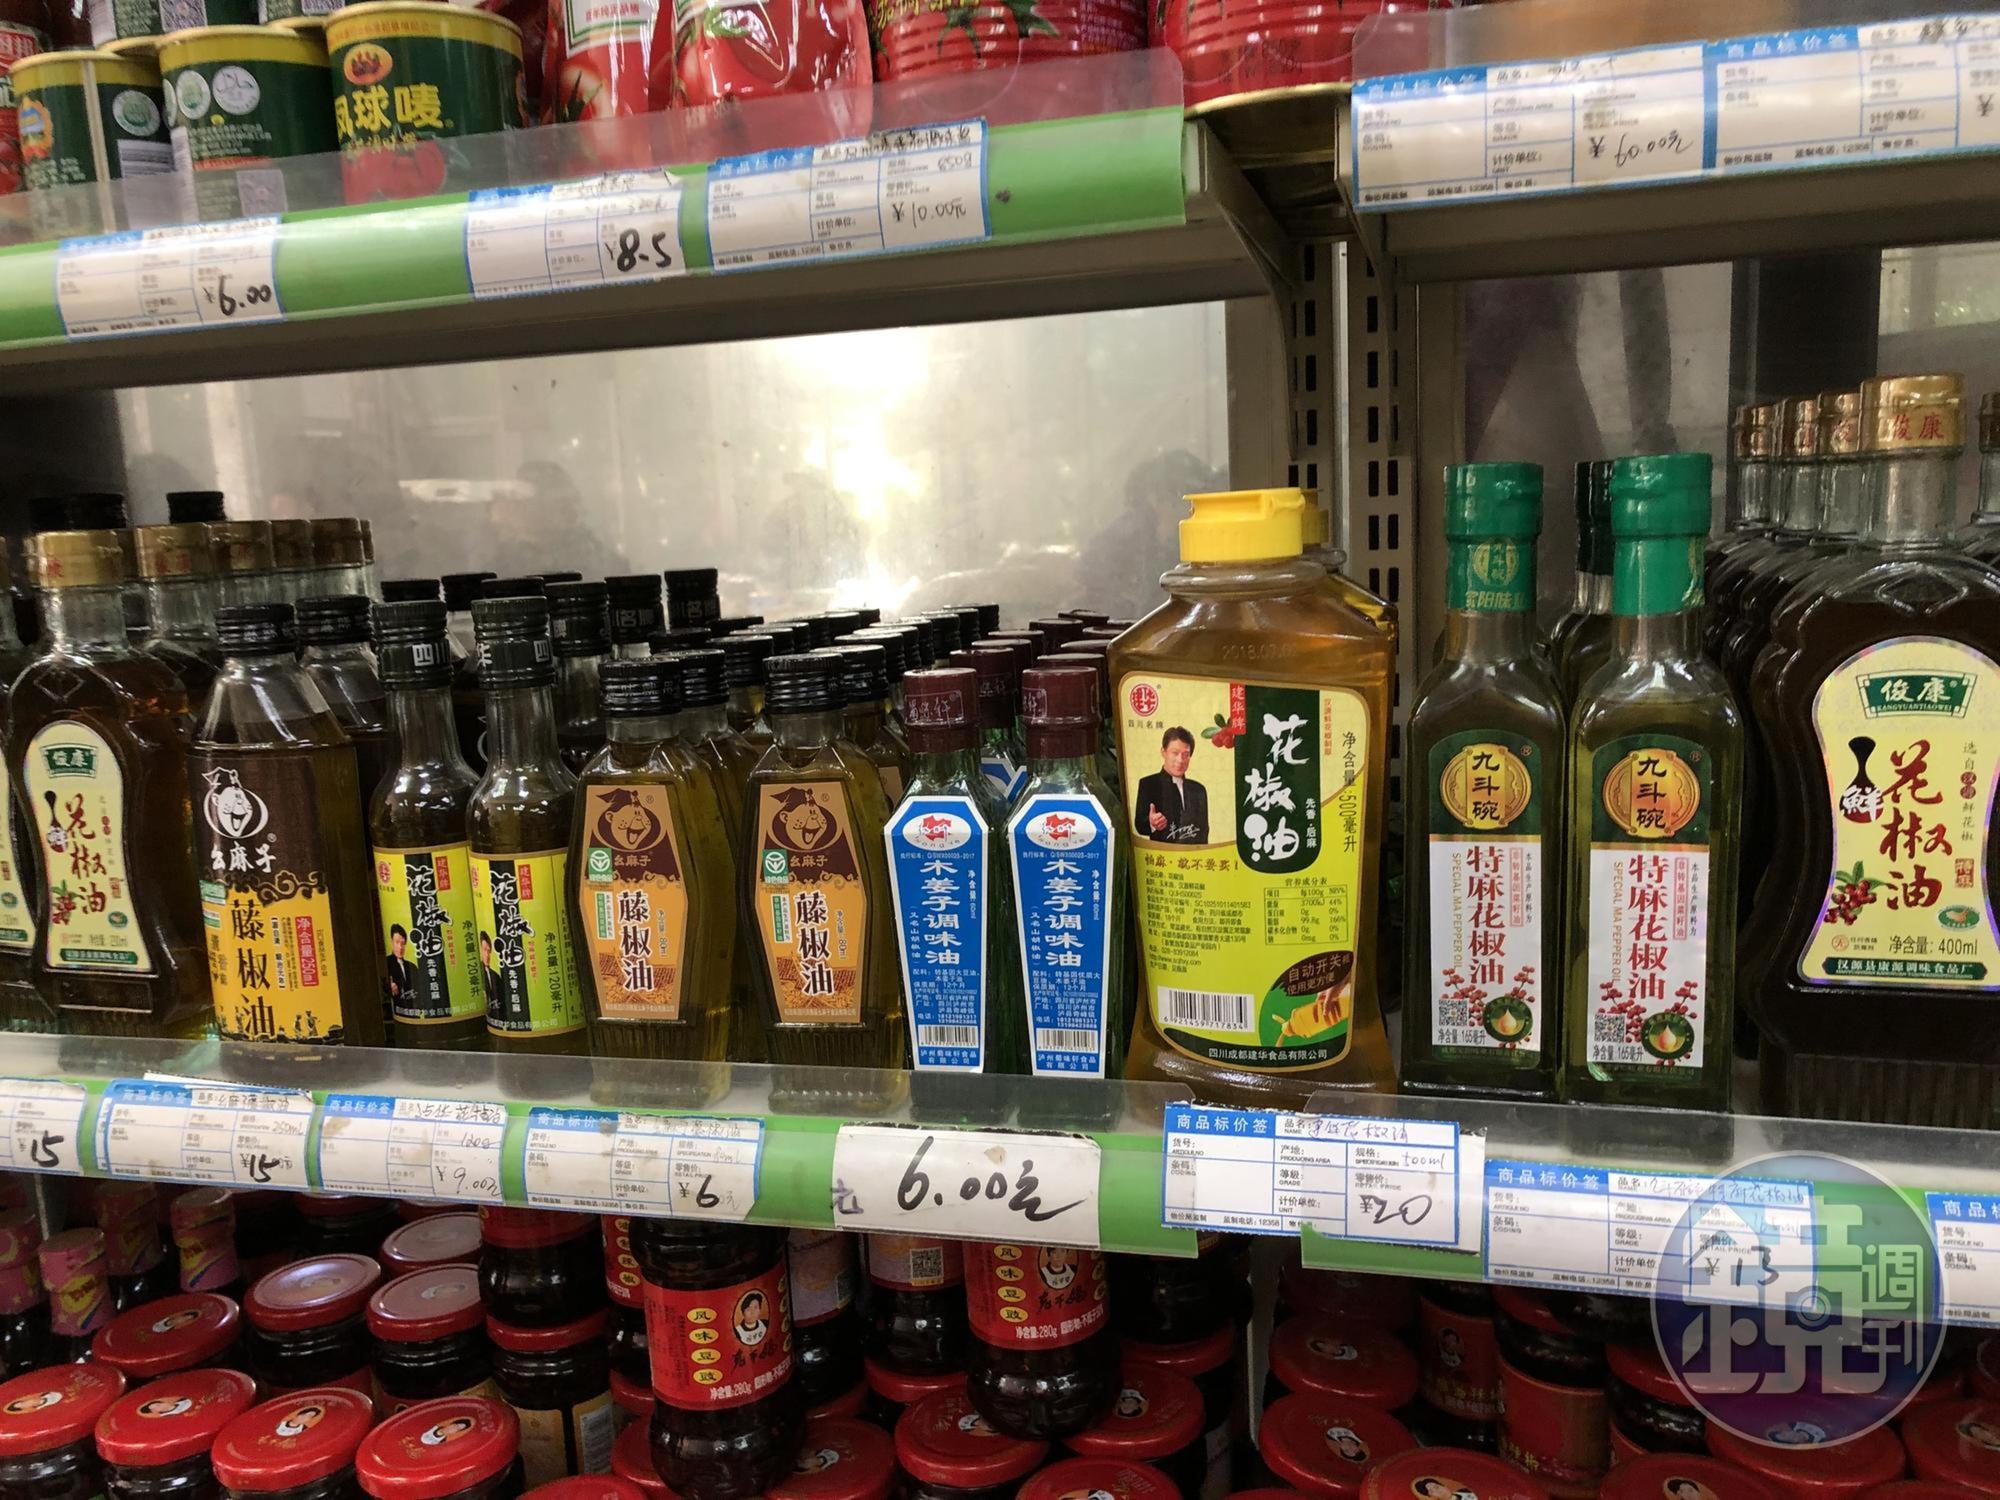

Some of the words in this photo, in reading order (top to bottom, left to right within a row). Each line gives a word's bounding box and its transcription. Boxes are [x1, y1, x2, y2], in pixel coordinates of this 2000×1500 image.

[1726, 33, 1849, 59] 商品标价签
[1230, 686, 1247, 730] 建华牌
[1880, 676, 1951, 703] 俊康
[1242, 712, 1311, 862] 花椒油
[1472, 751, 1501, 821] 九斗碗
[1636, 757, 1667, 829] 九斗碗
[64, 792, 108, 916] 花椒油
[1879, 738, 1954, 911] 花椒油
[616, 888, 655, 992] 藤椒油
[793, 889, 835, 996] 藤椒油
[919, 859, 963, 966] 木姜子调味油
[1041, 858, 1086, 968] 木姜子调味油
[1466, 845, 1507, 986] 特麻花椒油
[1627, 854, 1670, 1000] 特麻花椒油
[1937, 938, 1978, 956] 400ml
[230, 899, 275, 1037] 藤椒油
[1208, 1047, 1328, 1061] 四川成都建华食品有限公司
[1176, 1113, 1270, 1134] 商品标价签
[1498, 1167, 1601, 1191] 商品标价签
[1000, 1245, 1027, 1321] 风味豆豉
[691, 1309, 720, 1382] 风味豆豉
